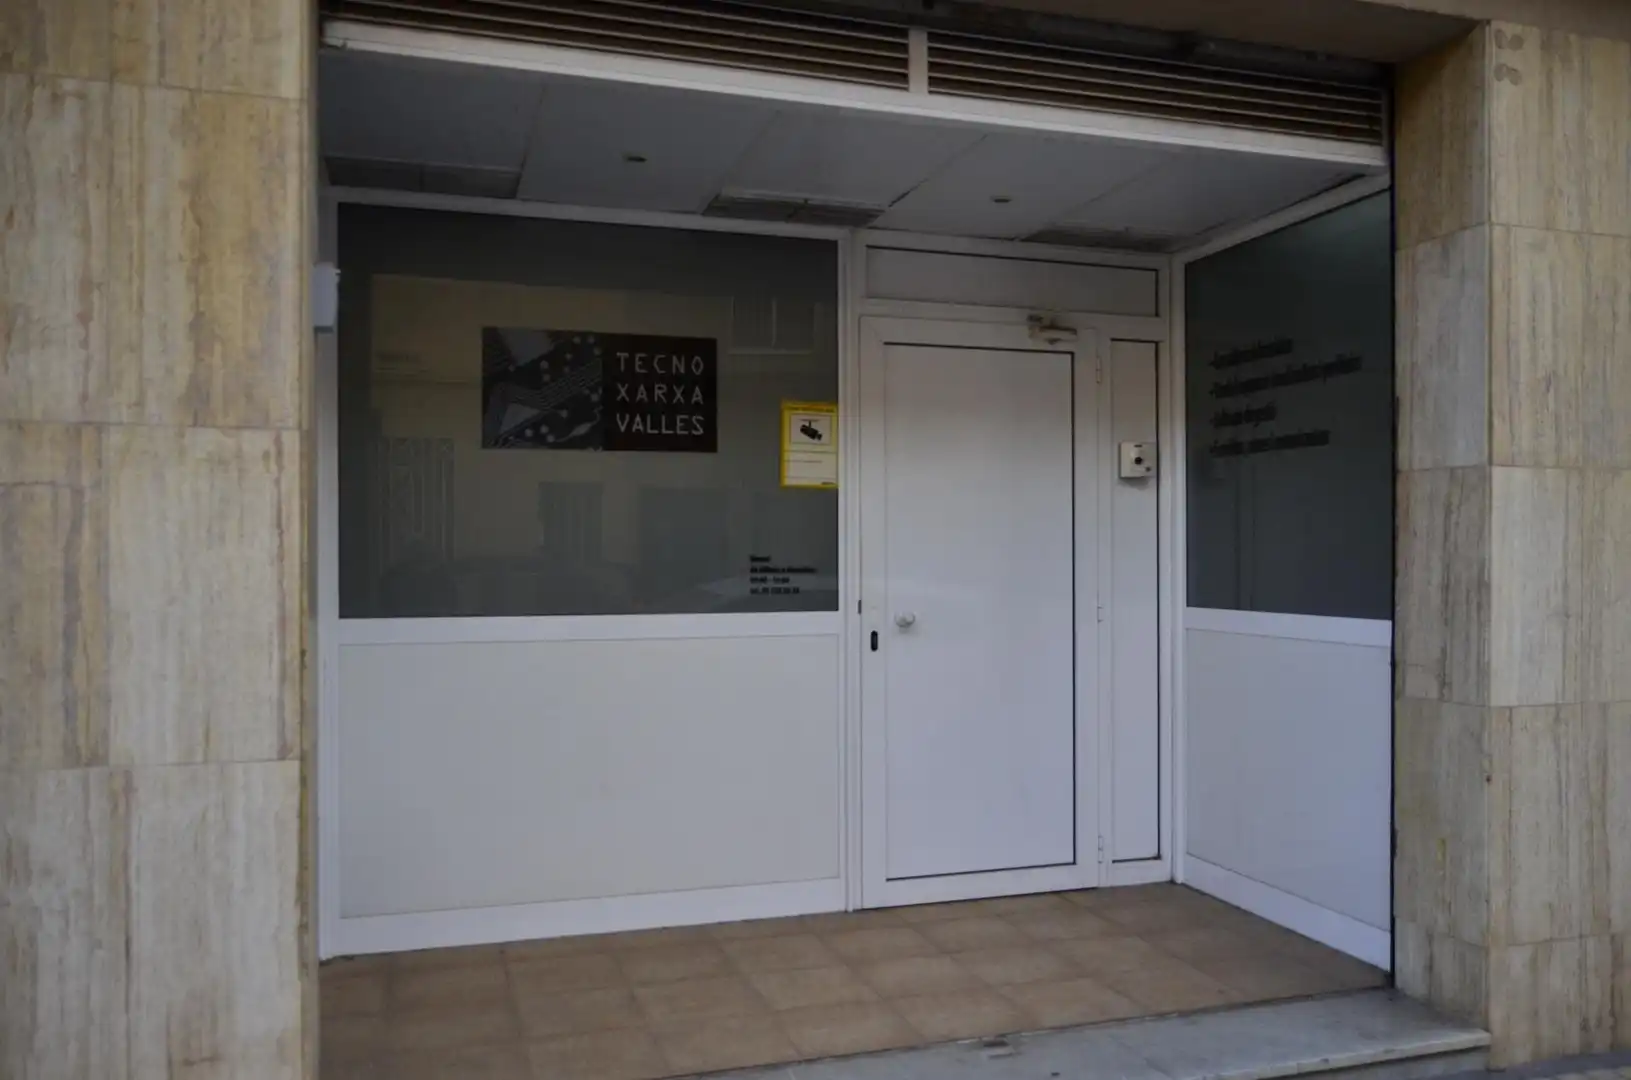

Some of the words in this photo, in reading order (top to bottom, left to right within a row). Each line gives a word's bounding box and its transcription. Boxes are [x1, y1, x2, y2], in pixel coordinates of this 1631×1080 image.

[616, 352, 704, 375] TECNO
[616, 382, 704, 404] XARXA
[616, 413, 705, 435] VALLES
